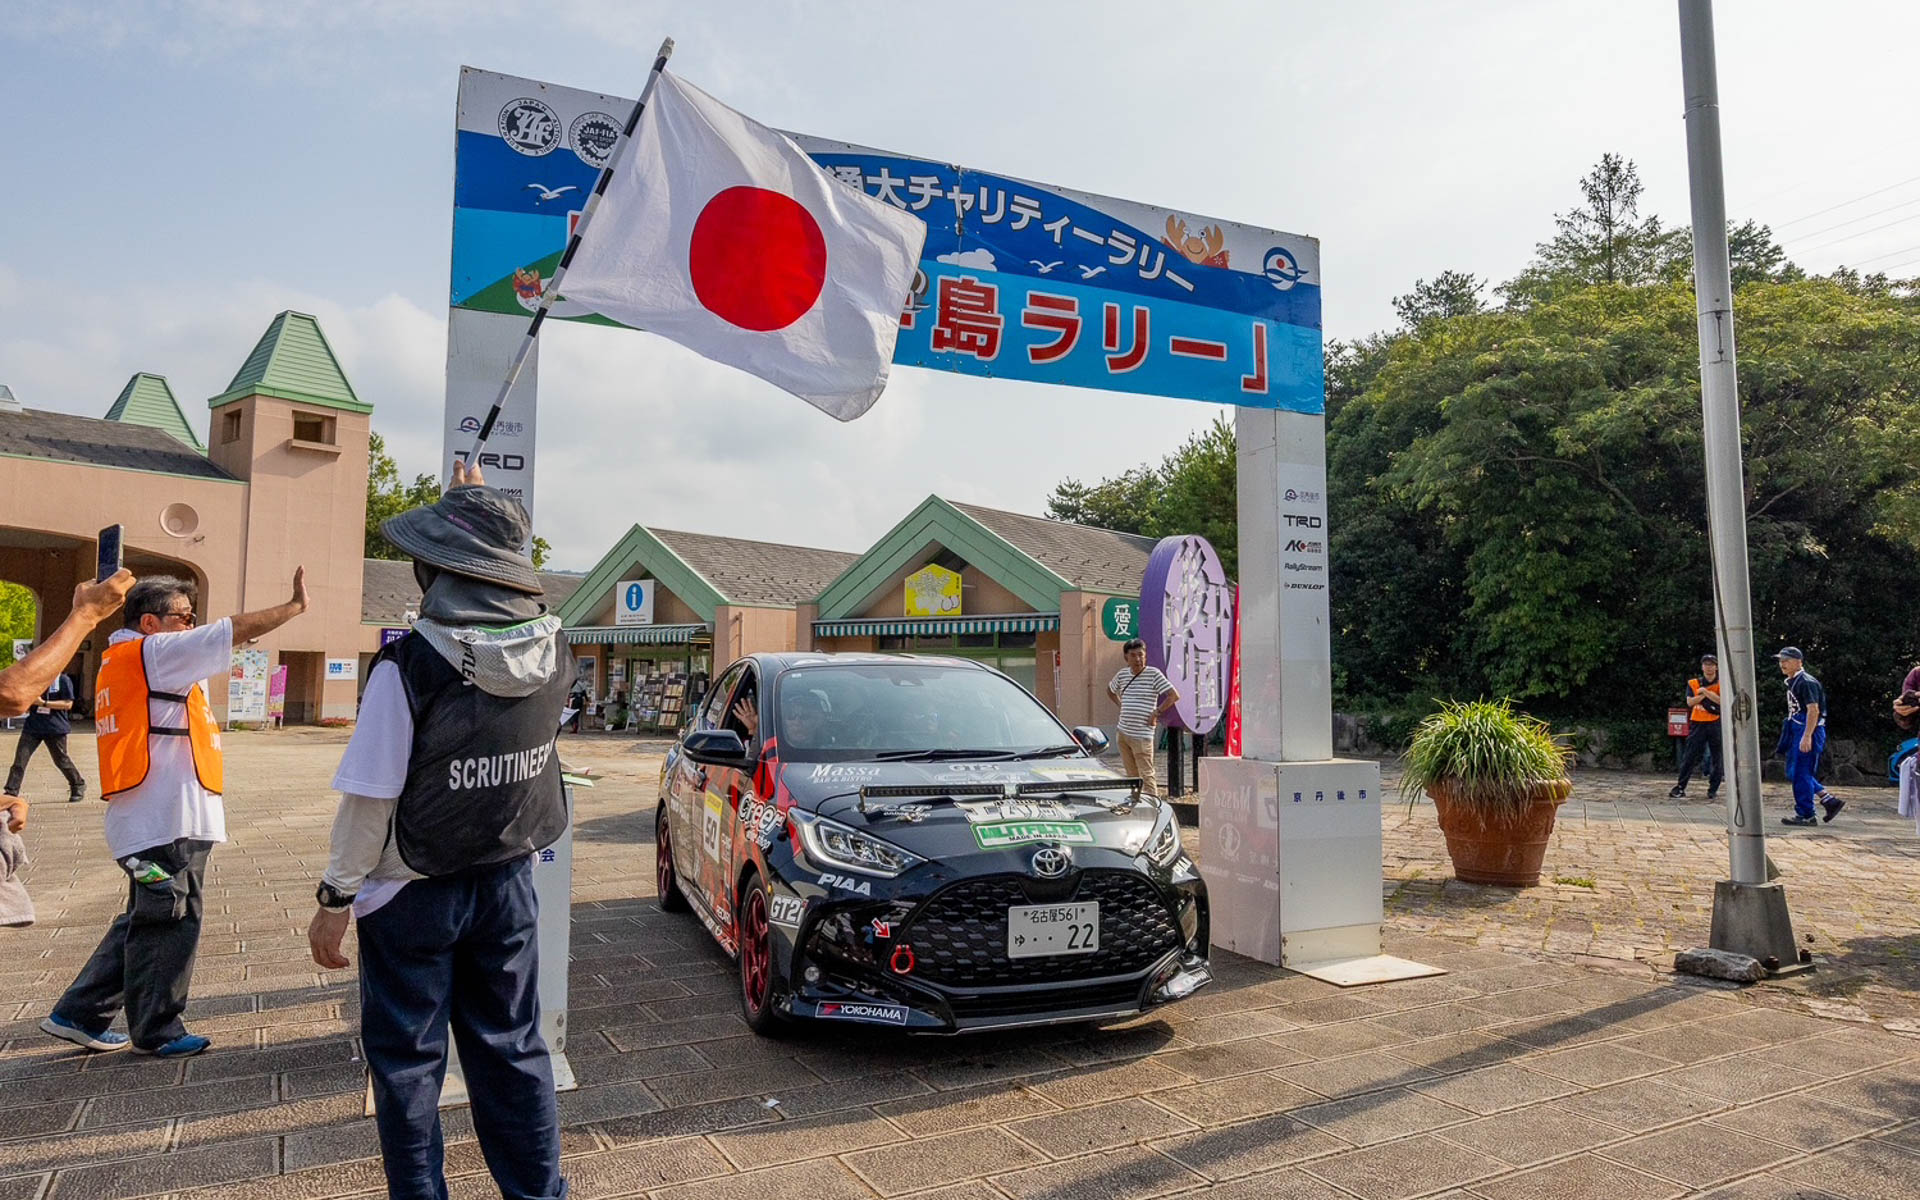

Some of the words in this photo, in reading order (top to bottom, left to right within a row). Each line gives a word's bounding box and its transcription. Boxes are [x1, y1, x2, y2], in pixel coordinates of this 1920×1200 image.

[518, 100, 548, 111] JAPAN
[900, 274, 1270, 394] 島ラリー」
[494, 420, 523, 433] 丹後市
[1283, 514, 1322, 529] TRD
[1284, 562, 1323, 572] RallyStream
[1114, 603, 1132, 636] 愛
[809, 763, 881, 778] Massa
[840, 775, 873, 783] BISTRO
[738, 790, 787, 836] Creer
[817, 873, 872, 897] PIAA
[1014, 934, 1026, 948] ゆ
[839, 1004, 902, 1021] YOKOHAMA
